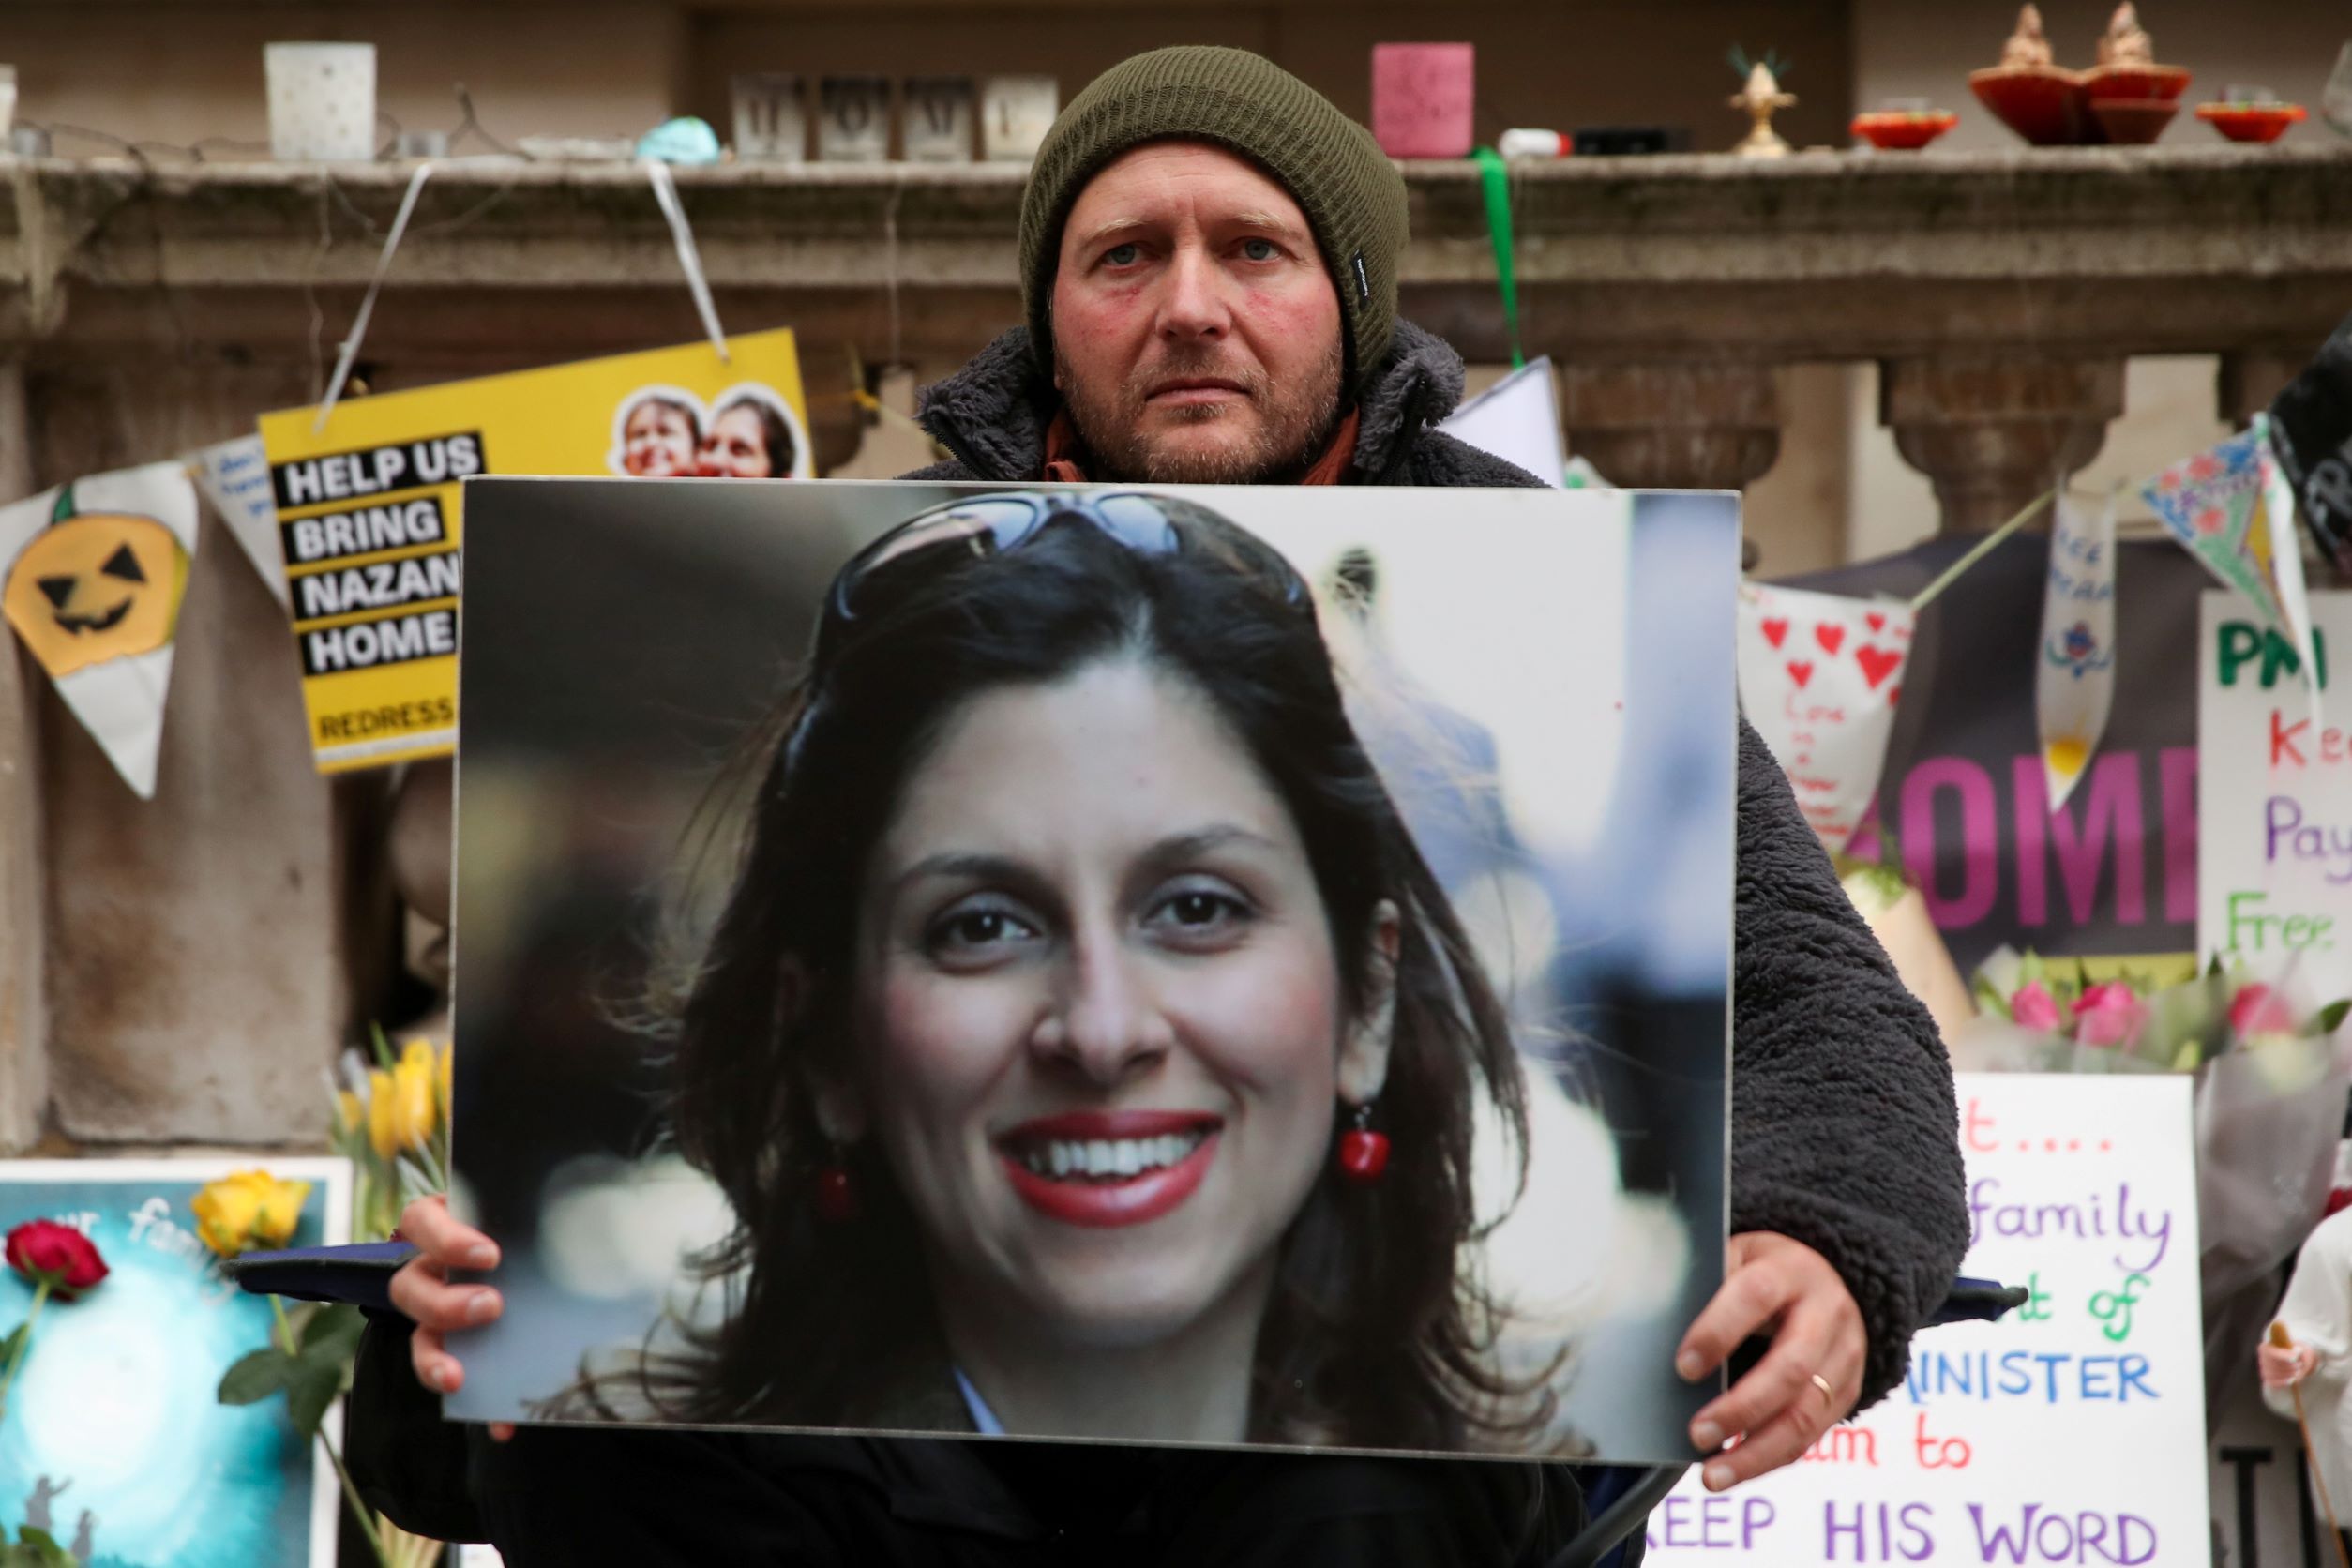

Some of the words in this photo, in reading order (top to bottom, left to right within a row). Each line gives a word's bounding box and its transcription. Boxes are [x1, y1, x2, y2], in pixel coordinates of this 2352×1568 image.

[283, 446, 406, 505] HELP
[413, 434, 480, 484] US
[293, 499, 443, 562] BRING
[309, 611, 455, 673] HOME
[2217, 618, 2328, 692] PM
[319, 697, 455, 740] REDRESS
[2270, 709, 2352, 769] Ke
[2225, 892, 2336, 956] Free
[1968, 1177, 2173, 1274] family
[2088, 1272, 2152, 1343] of
[1907, 1350, 2163, 1404] INISTER
[1915, 1410, 1973, 1470] to
[1645, 1495, 1778, 1551] EEP
[1824, 1500, 1936, 1564] HIS
[1967, 1501, 2157, 1567] WORD
